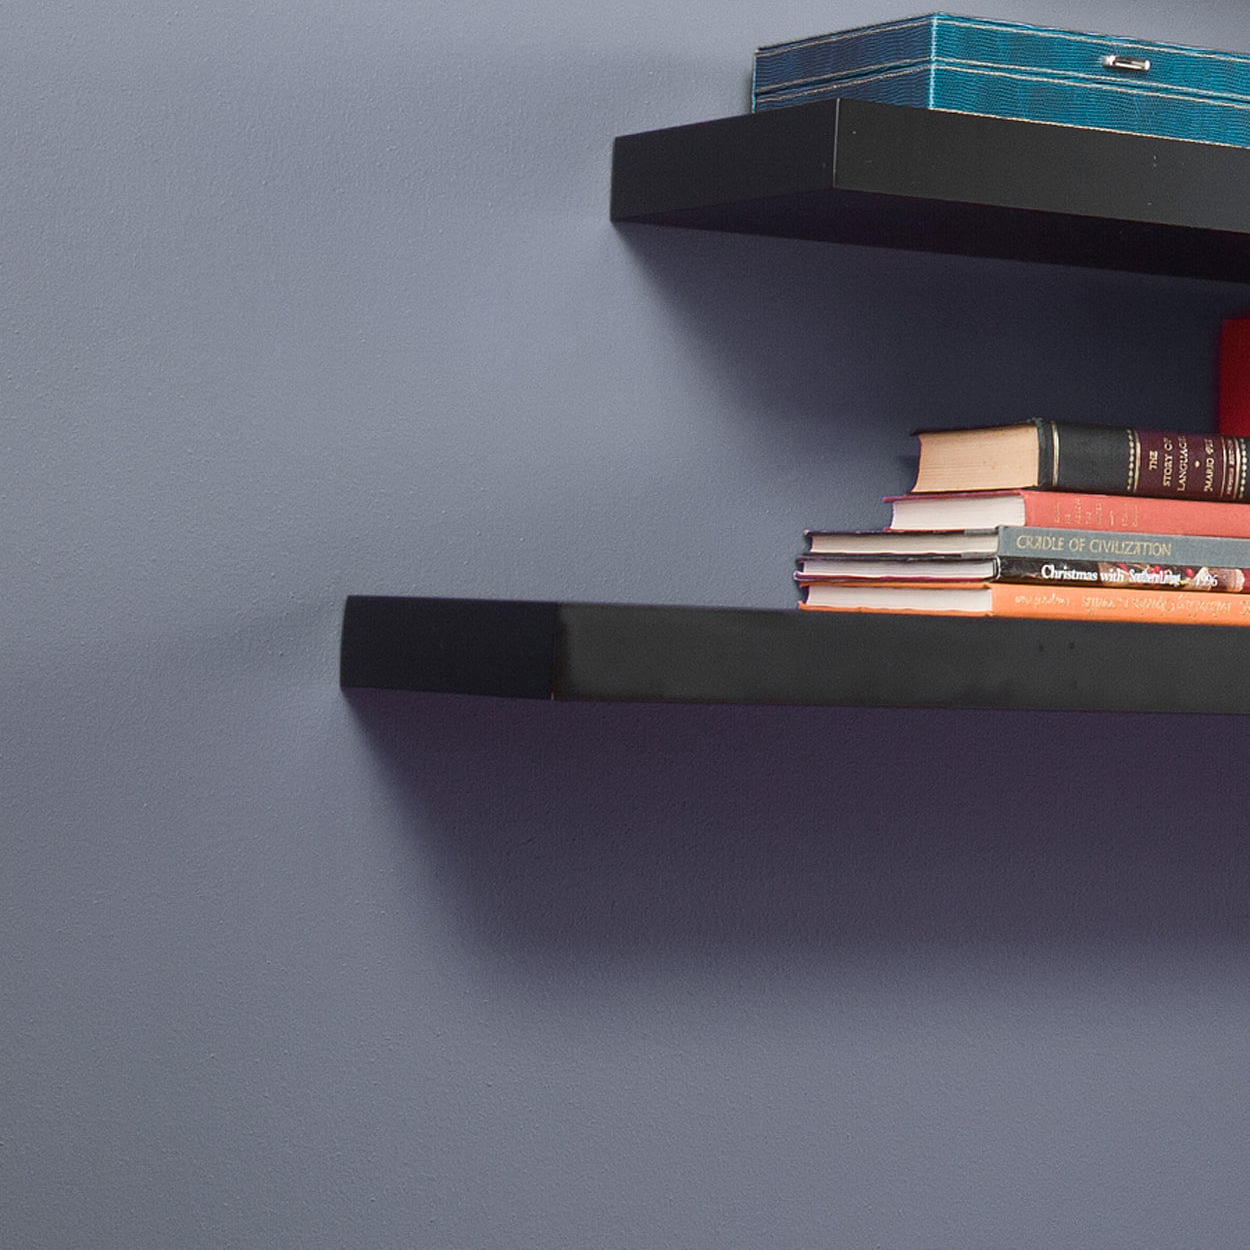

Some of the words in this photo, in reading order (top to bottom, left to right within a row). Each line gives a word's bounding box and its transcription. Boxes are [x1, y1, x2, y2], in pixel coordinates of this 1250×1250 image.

[1149, 450, 1158, 471] THE
[1162, 454, 1174, 487] STORY
[1016, 534, 1064, 551] CRADLE
[1069, 537, 1086, 551] OF
[1089, 539, 1172, 557] CIVILIZATION
[1041, 563, 1098, 582] Christmas
[1100, 567, 1125, 583] with
